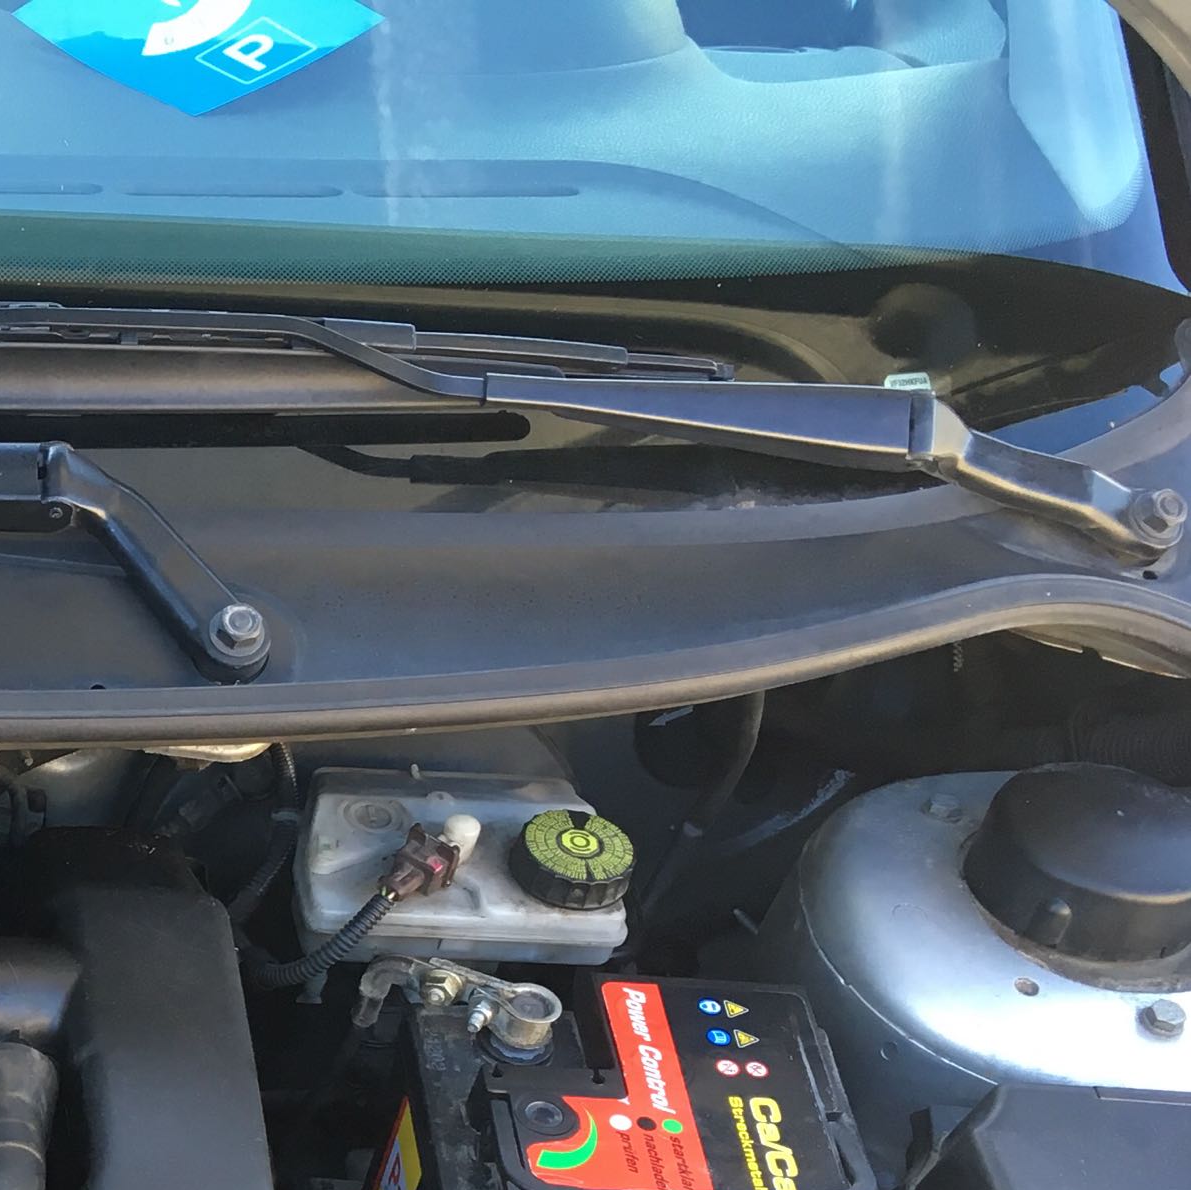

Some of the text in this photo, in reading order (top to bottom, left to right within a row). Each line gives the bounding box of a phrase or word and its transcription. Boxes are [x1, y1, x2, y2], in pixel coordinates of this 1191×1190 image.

[222, 34, 274, 71] P
[622, 987, 677, 1115] Power Control
